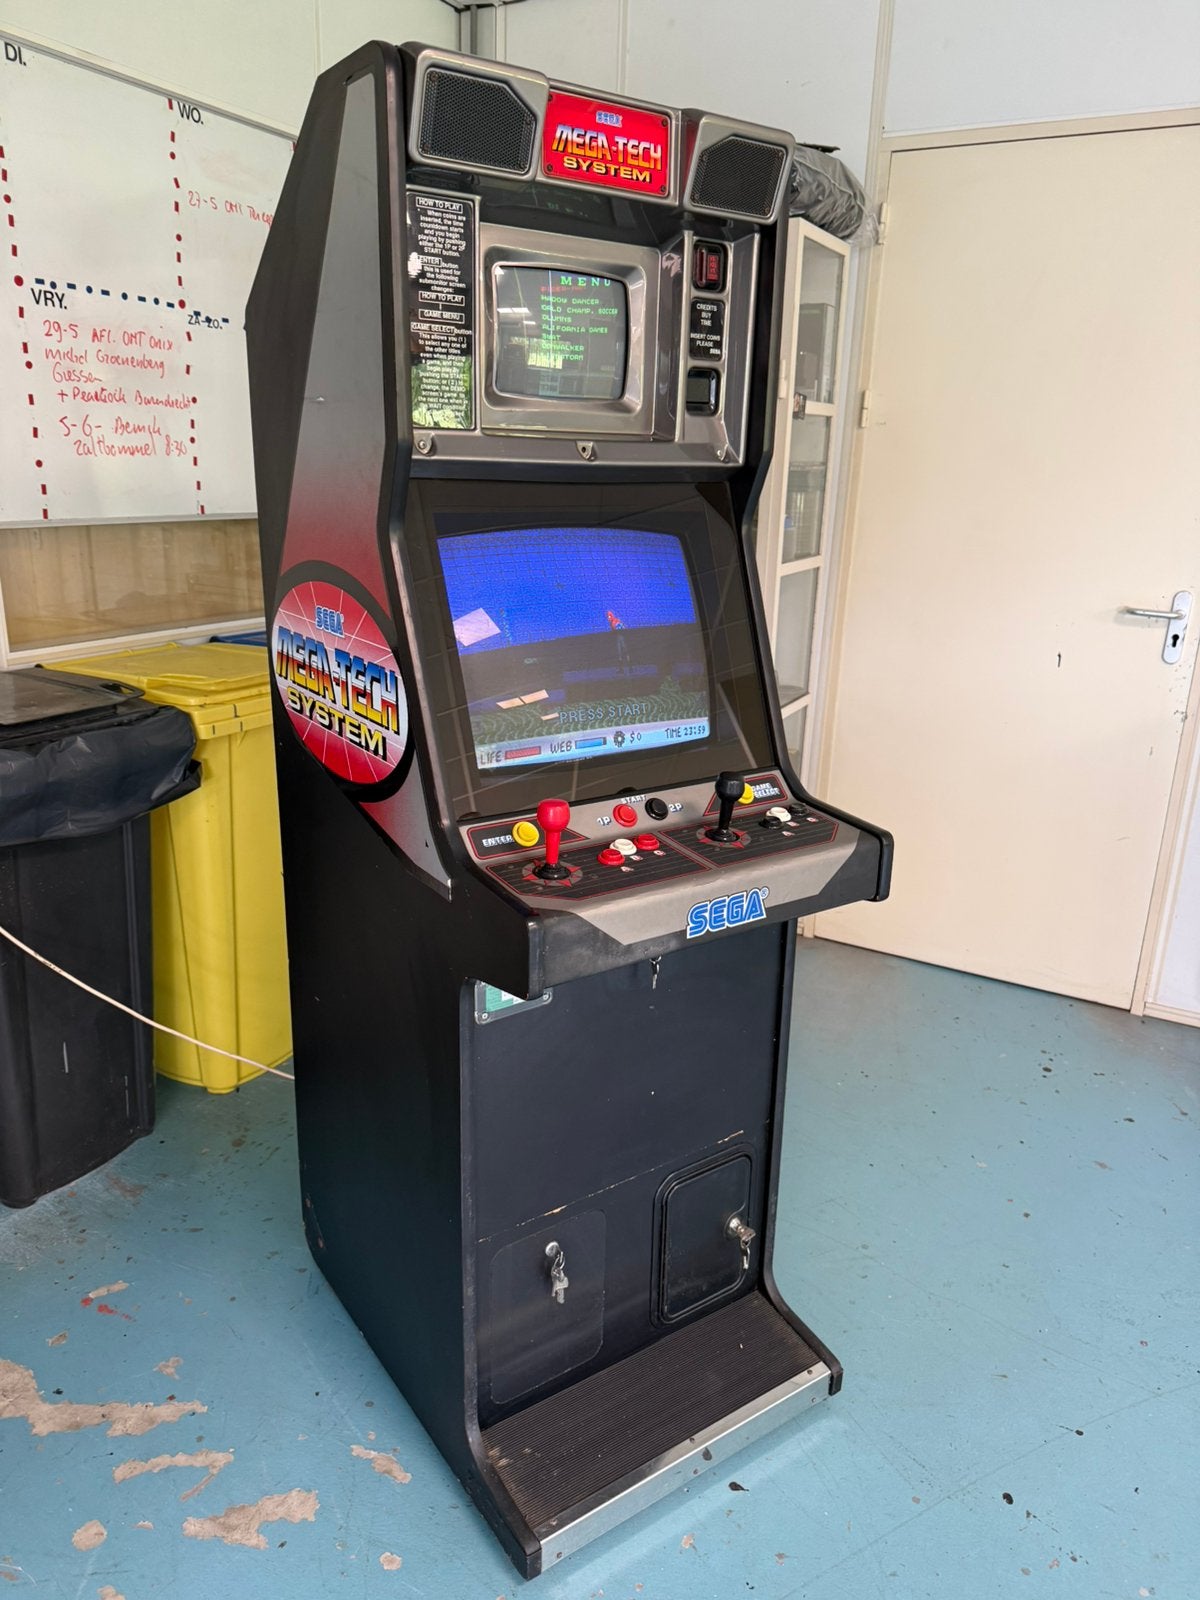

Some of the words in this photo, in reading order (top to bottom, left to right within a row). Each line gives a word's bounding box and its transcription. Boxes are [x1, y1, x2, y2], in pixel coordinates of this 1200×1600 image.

[4, 42, 27, 66] DI.
[177, 100, 204, 125] WO.
[596, 111, 622, 128] SEGA
[551, 124, 662, 171] MEGA-TECH
[563, 156, 652, 183] SYSTEM
[419, 198, 433, 207] HOW
[436, 200, 443, 208] TO
[445, 202, 460, 211] PLAY
[31, 288, 68, 310] VRY.
[421, 292, 436, 300] HOW
[447, 295, 462, 303] PLAY
[696, 303, 718, 312] CREDITS
[424, 310, 441, 319] GAME
[443, 311, 460, 320] MENU
[701, 311, 712, 319] BUY
[431, 324, 454, 334] SELECT
[701, 319, 712, 327] TIME
[43, 319, 79, 343] 29-5
[696, 340, 714, 348] PLEASE
[315, 605, 345, 638] SEGA
[276, 626, 399, 735] MEGA-TECH
[559, 706, 604, 724] PRESS
[608, 703, 648, 718] START
[286, 686, 386, 758] SYSTEM
[664, 727, 682, 738] TIME
[683, 724, 707, 737] 23:59
[550, 740, 573, 754] WEB
[480, 752, 502, 765] LIFE
[621, 795, 647, 805] START
[754, 788, 780, 799] SELECT
[668, 802, 685, 813] 2P
[596, 816, 612, 826] 1P
[482, 834, 514, 848] ENTER
